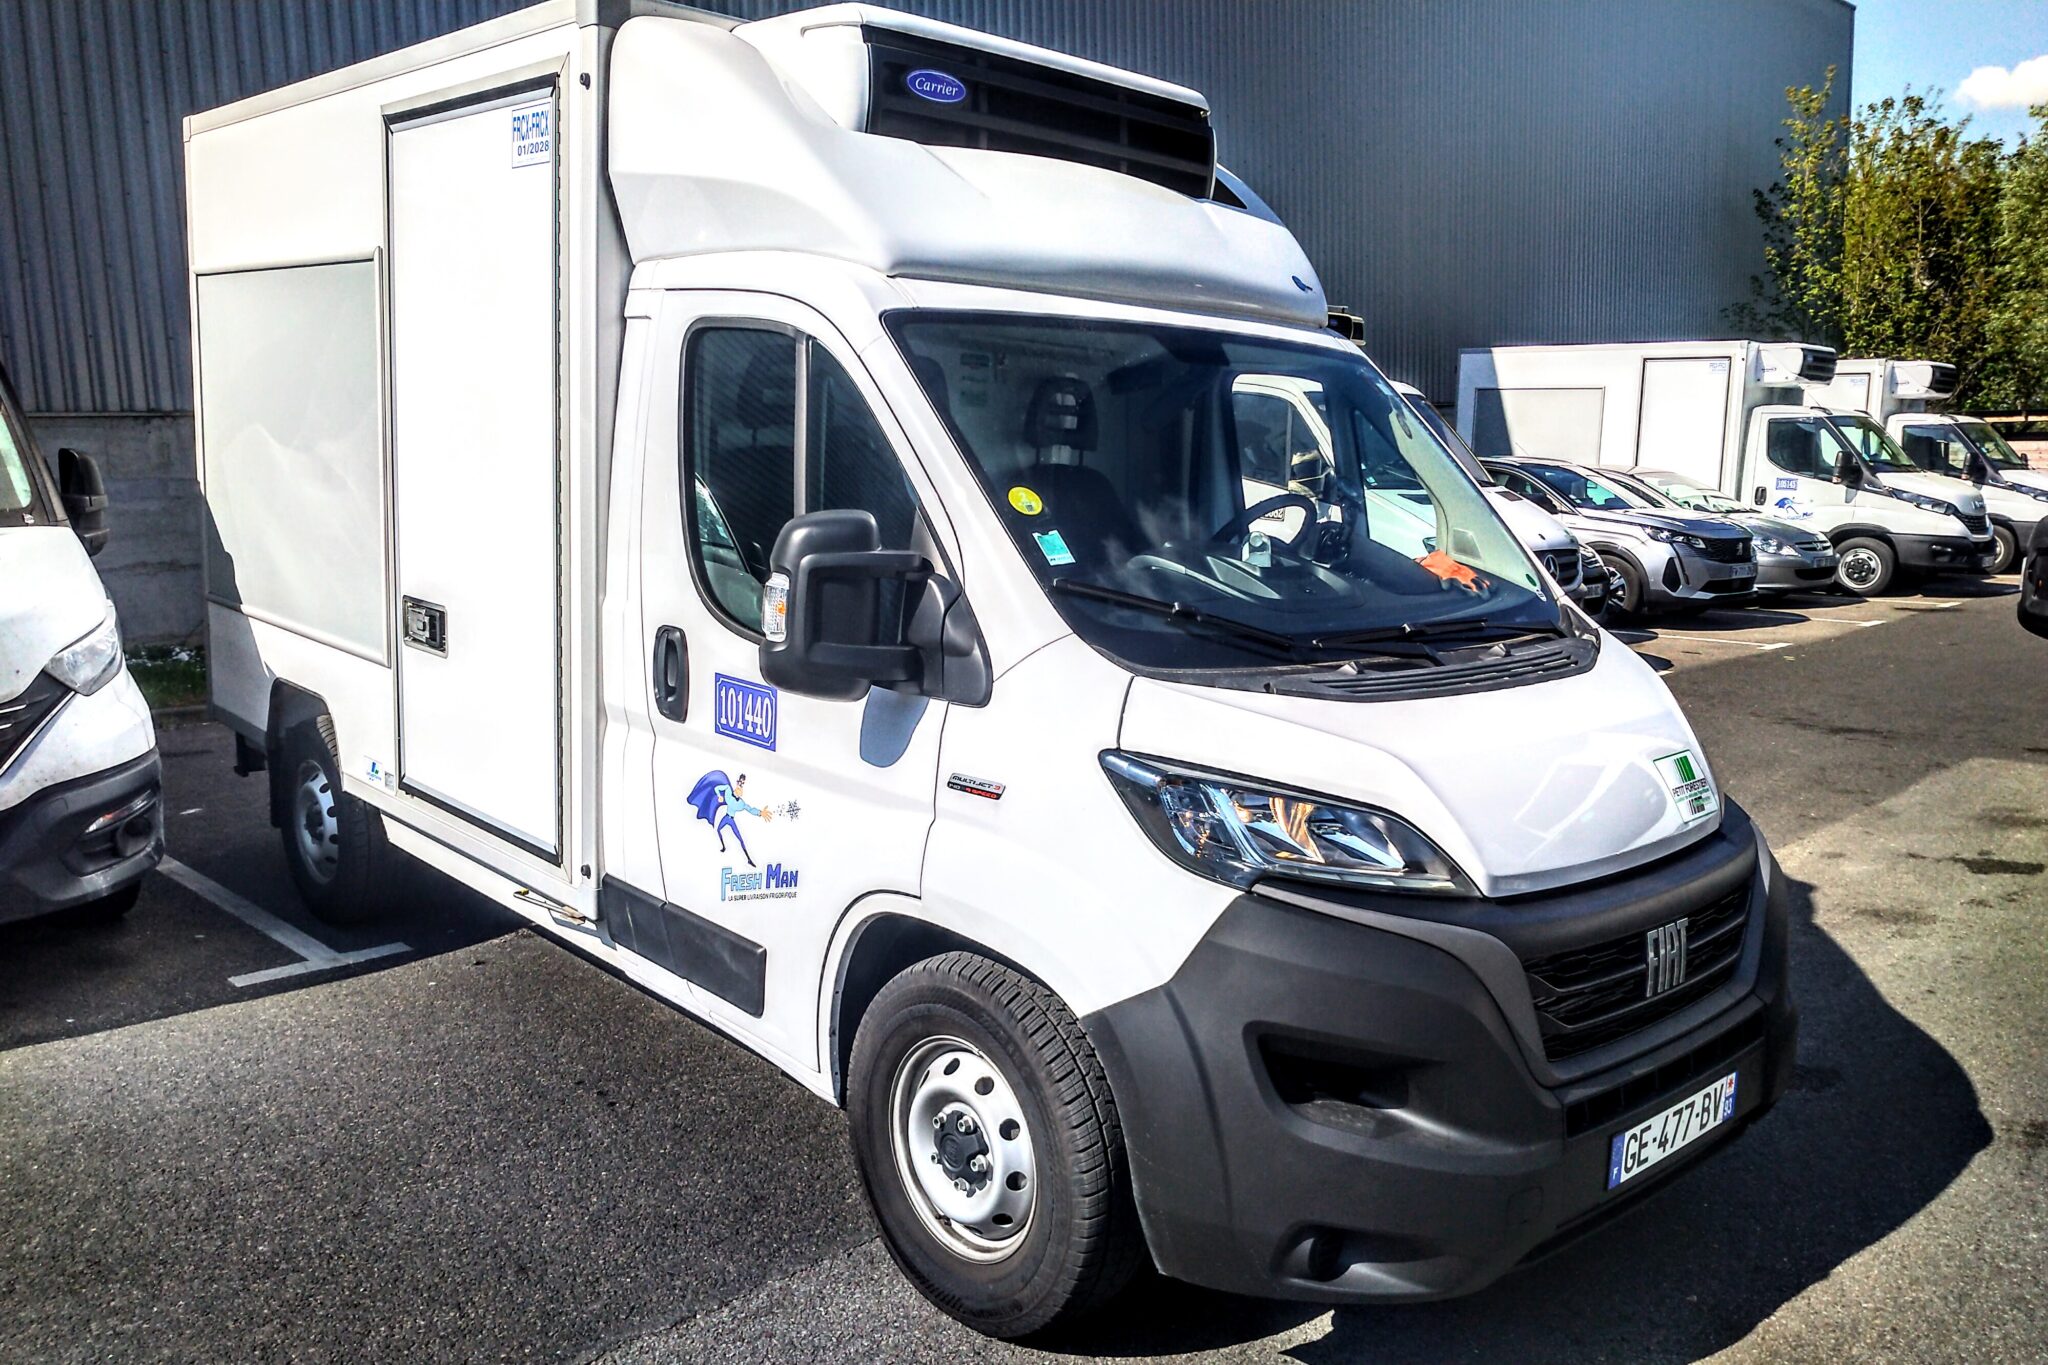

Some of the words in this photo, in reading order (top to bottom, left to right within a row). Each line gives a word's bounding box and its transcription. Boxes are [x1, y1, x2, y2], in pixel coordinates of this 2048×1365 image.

[915, 77, 958, 96] Carrier
[513, 109, 549, 142] FRCX-FRCX
[518, 140, 549, 156] 01/2028
[721, 686, 772, 738] 101440
[952, 775, 993, 788] MULTIJET
[1672, 785, 1685, 797] PETIT
[1685, 777, 1708, 794] FORESTIER
[734, 893, 746, 901] SUPER
[1646, 917, 1689, 997] FIAT
[1612, 1167, 1618, 1179] F
[1624, 1083, 1724, 1174] GE-477-BV
[1723, 1098, 1733, 1116] 93
